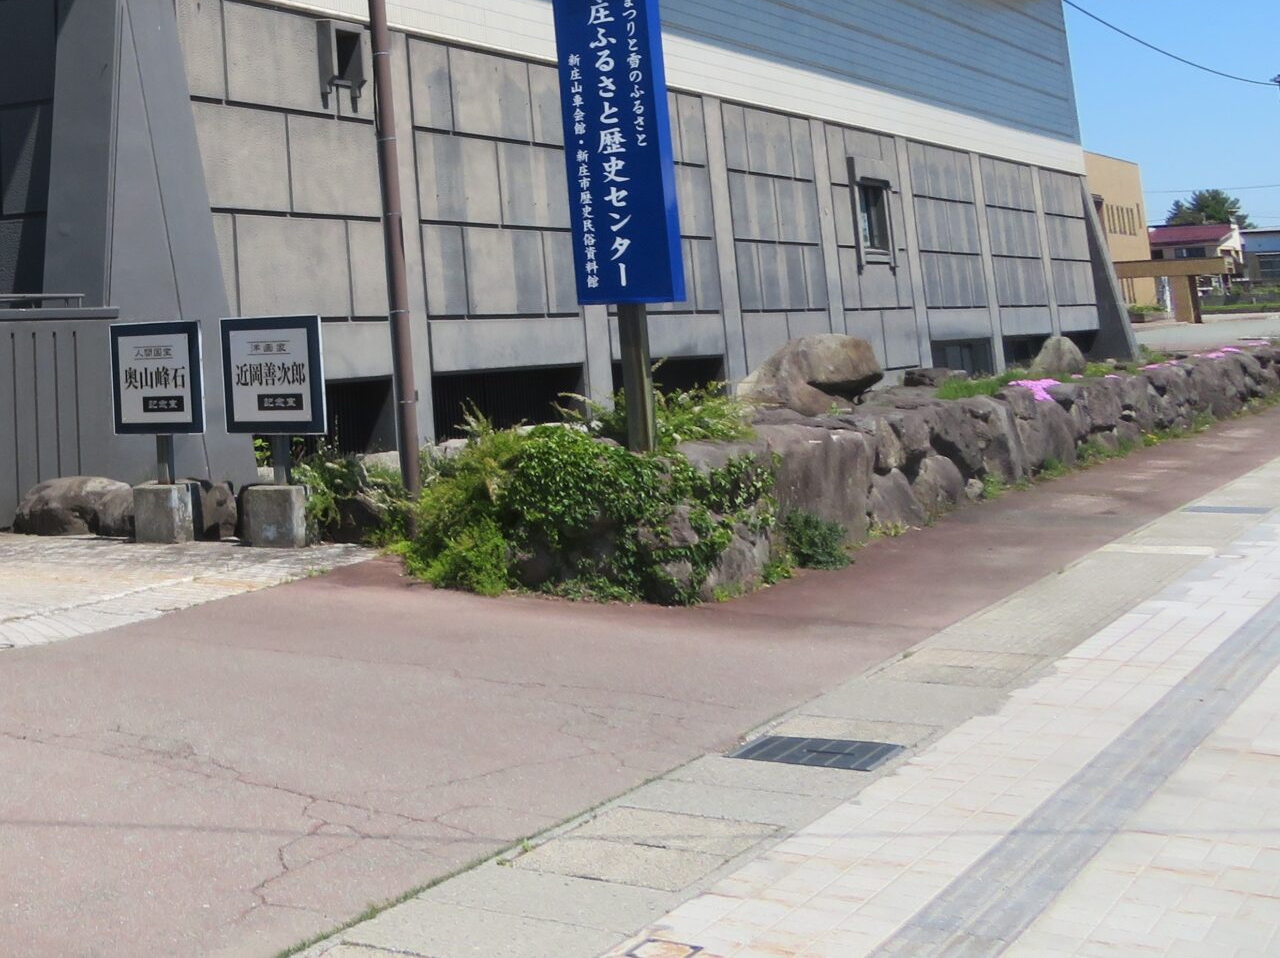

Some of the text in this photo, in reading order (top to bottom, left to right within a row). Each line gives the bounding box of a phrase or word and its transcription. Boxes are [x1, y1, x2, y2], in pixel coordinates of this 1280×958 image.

[124, 365, 186, 390] 奥山峰石
[235, 361, 306, 387] 近岡善次郎
